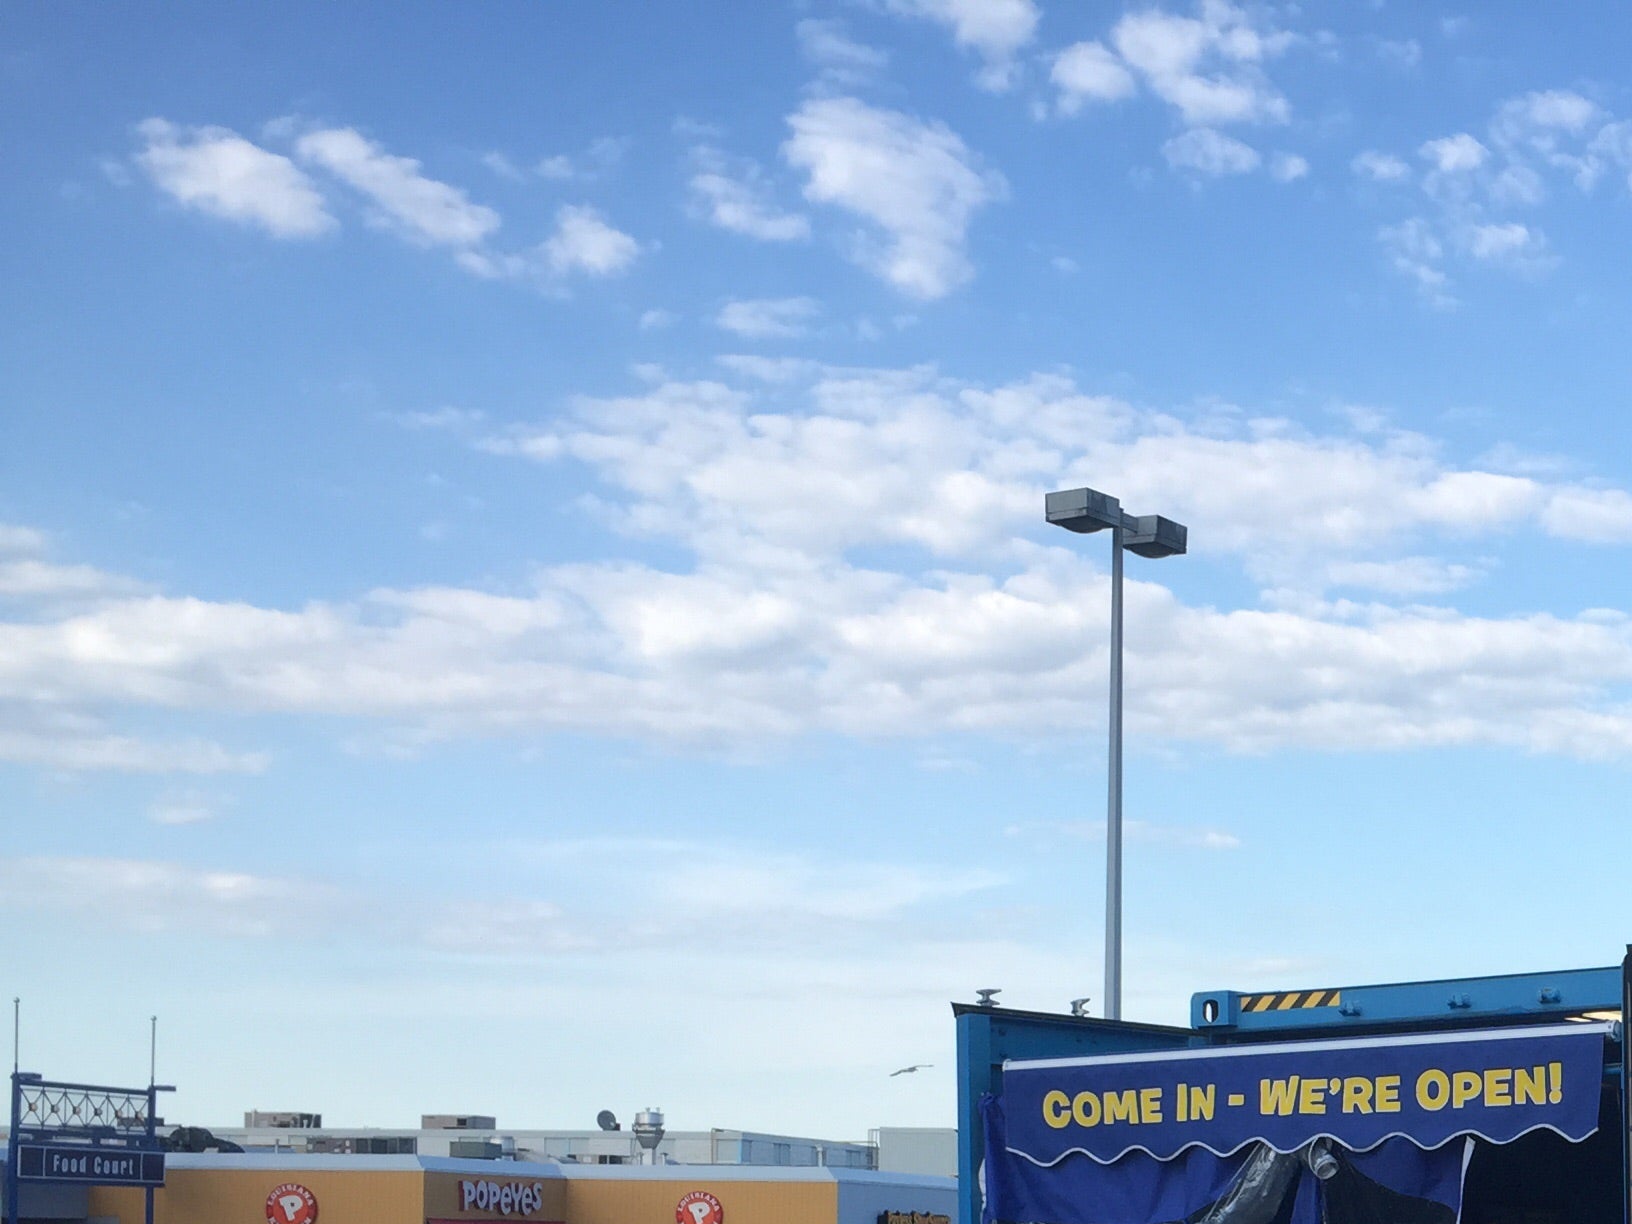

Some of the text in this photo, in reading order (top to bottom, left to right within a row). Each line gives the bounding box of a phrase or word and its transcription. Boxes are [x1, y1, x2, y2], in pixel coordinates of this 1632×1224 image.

[1042, 1087, 1163, 1128] COME
[1176, 1083, 1215, 1122] IN
[1259, 1074, 1401, 1116] WE'RE
[1415, 1062, 1563, 1109] OPEN!
[53, 1154, 134, 1175] Food Court
[267, 1184, 314, 1206] LOUISIANA
[677, 1192, 720, 1212] LOUISIANA
